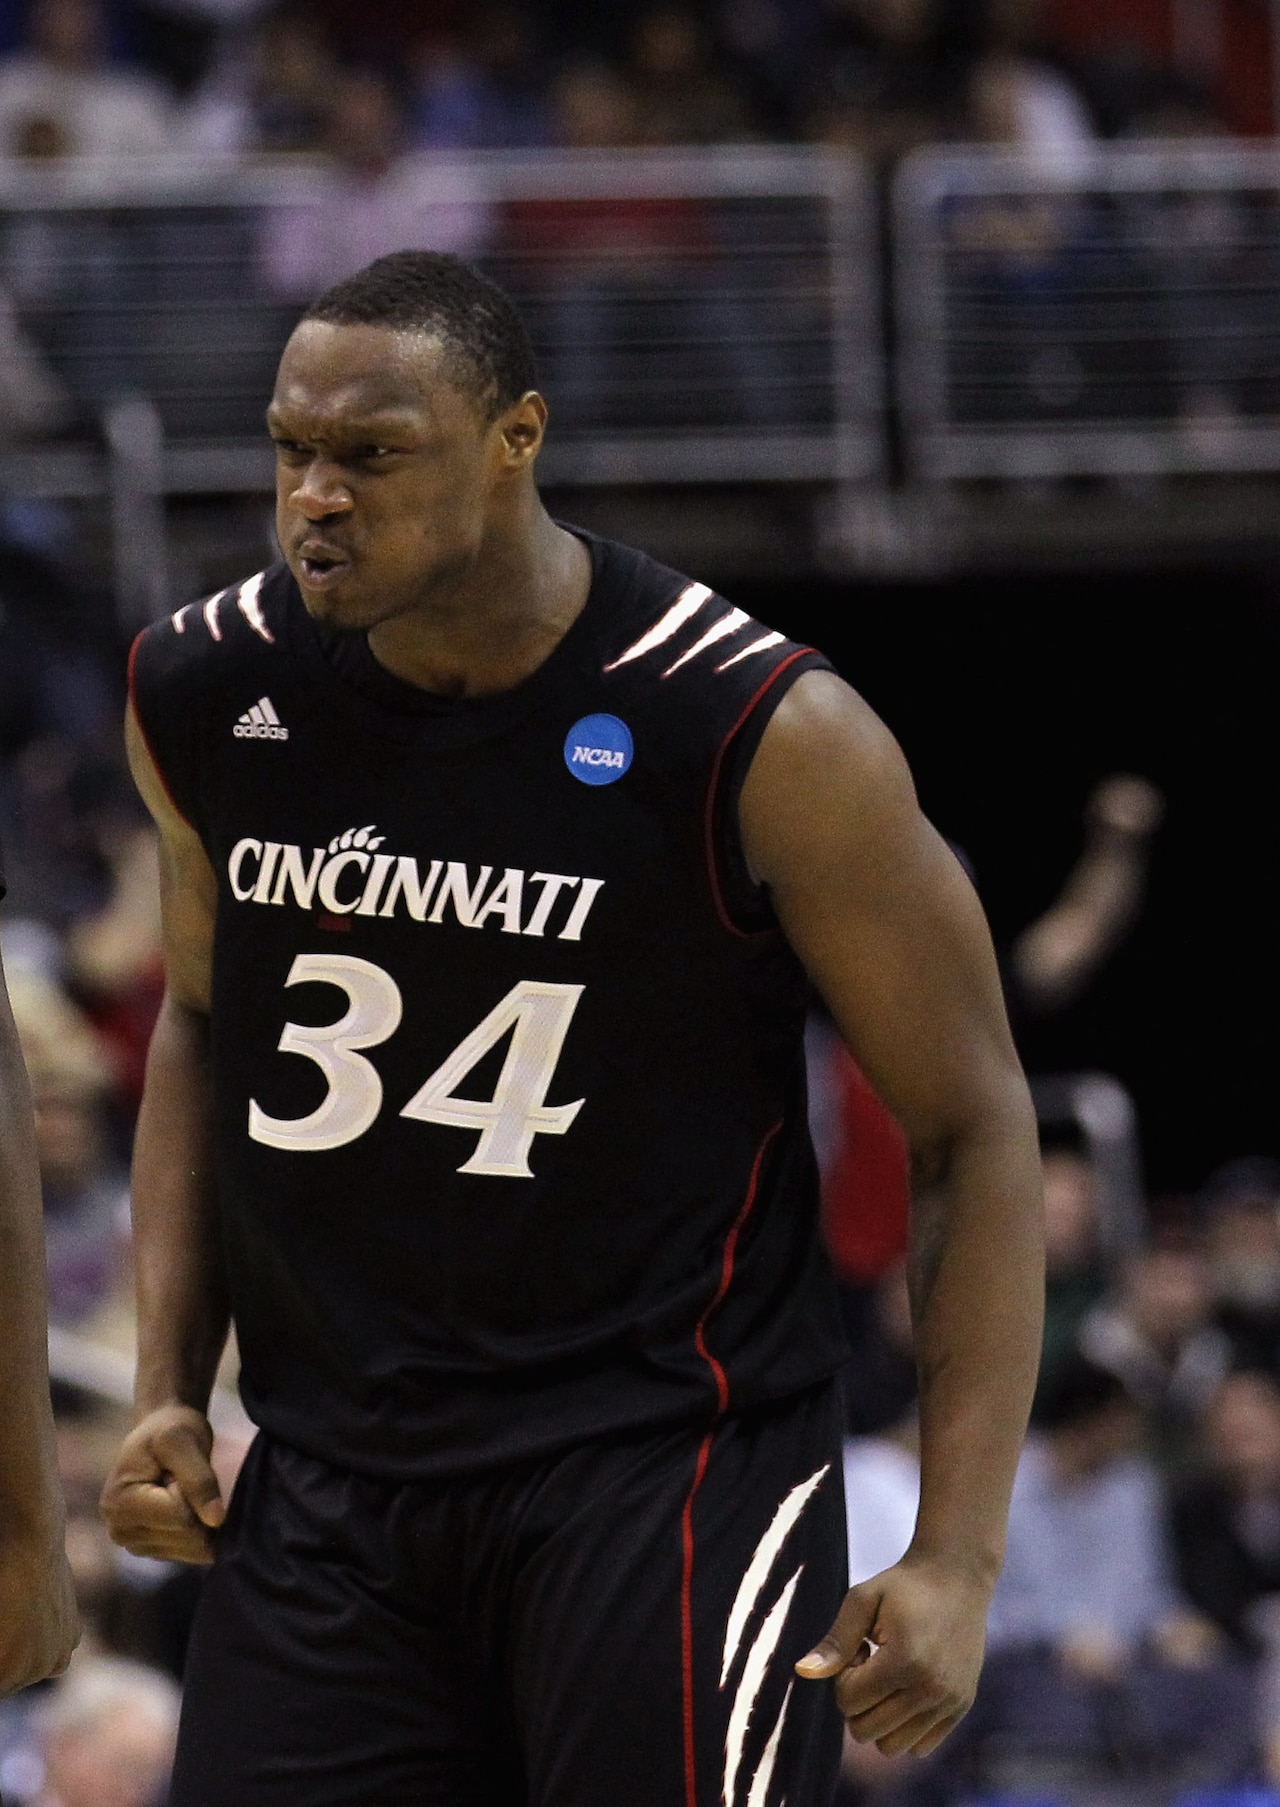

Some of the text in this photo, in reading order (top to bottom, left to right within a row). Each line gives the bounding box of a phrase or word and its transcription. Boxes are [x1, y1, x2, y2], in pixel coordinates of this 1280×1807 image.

[232, 724, 289, 741] adidas
[571, 745, 625, 769] NCAA
[228, 836, 606, 941] CINCINNATI
[248, 953, 587, 1178] 34
